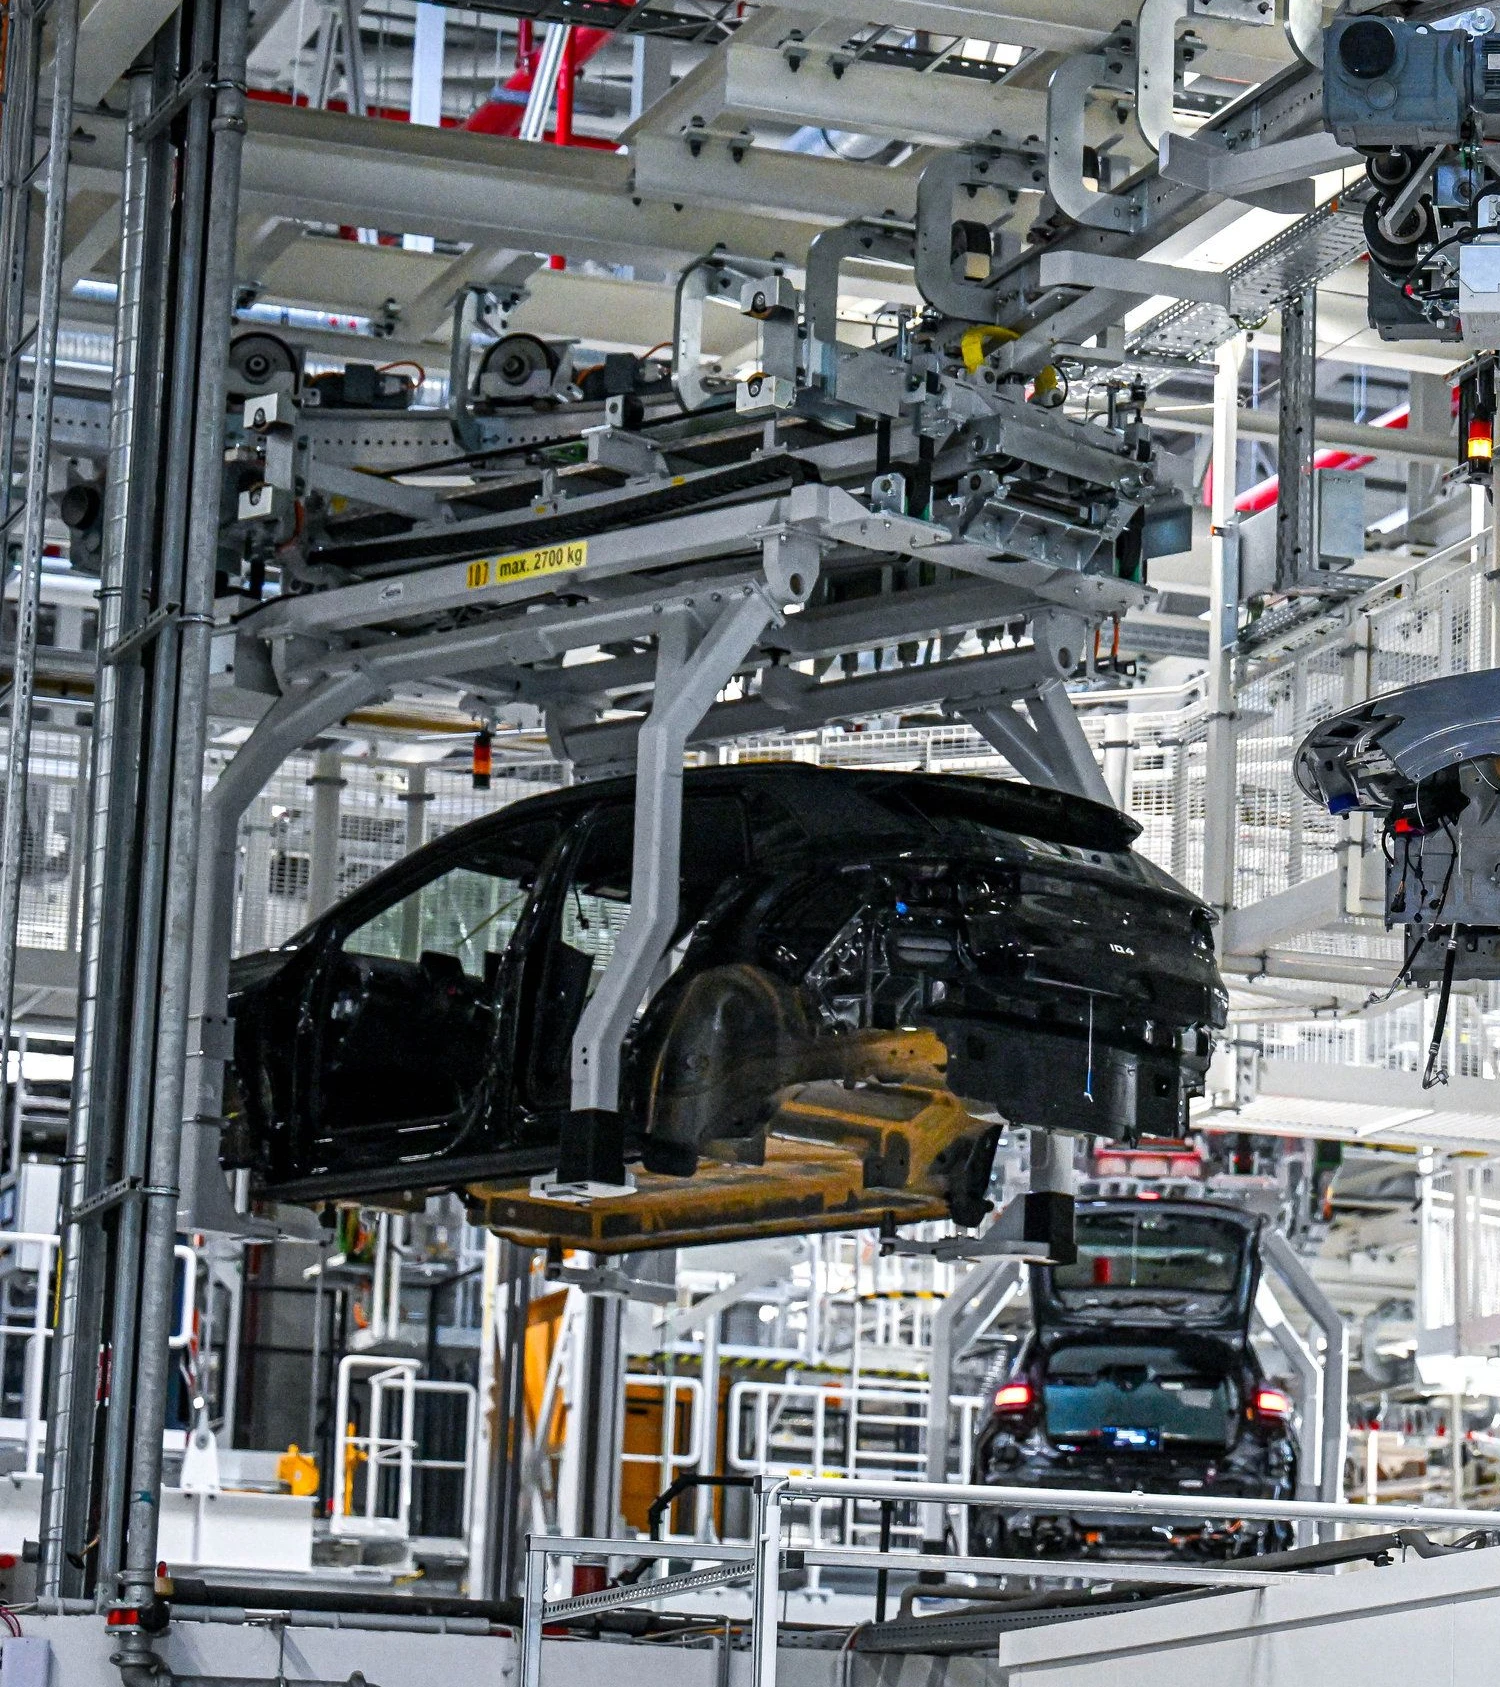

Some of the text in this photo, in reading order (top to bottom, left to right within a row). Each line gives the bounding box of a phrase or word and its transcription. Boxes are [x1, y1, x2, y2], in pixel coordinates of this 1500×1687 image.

[500, 559, 530, 577] max.
[533, 548, 563, 570] 2700
[567, 547, 583, 566] kg
